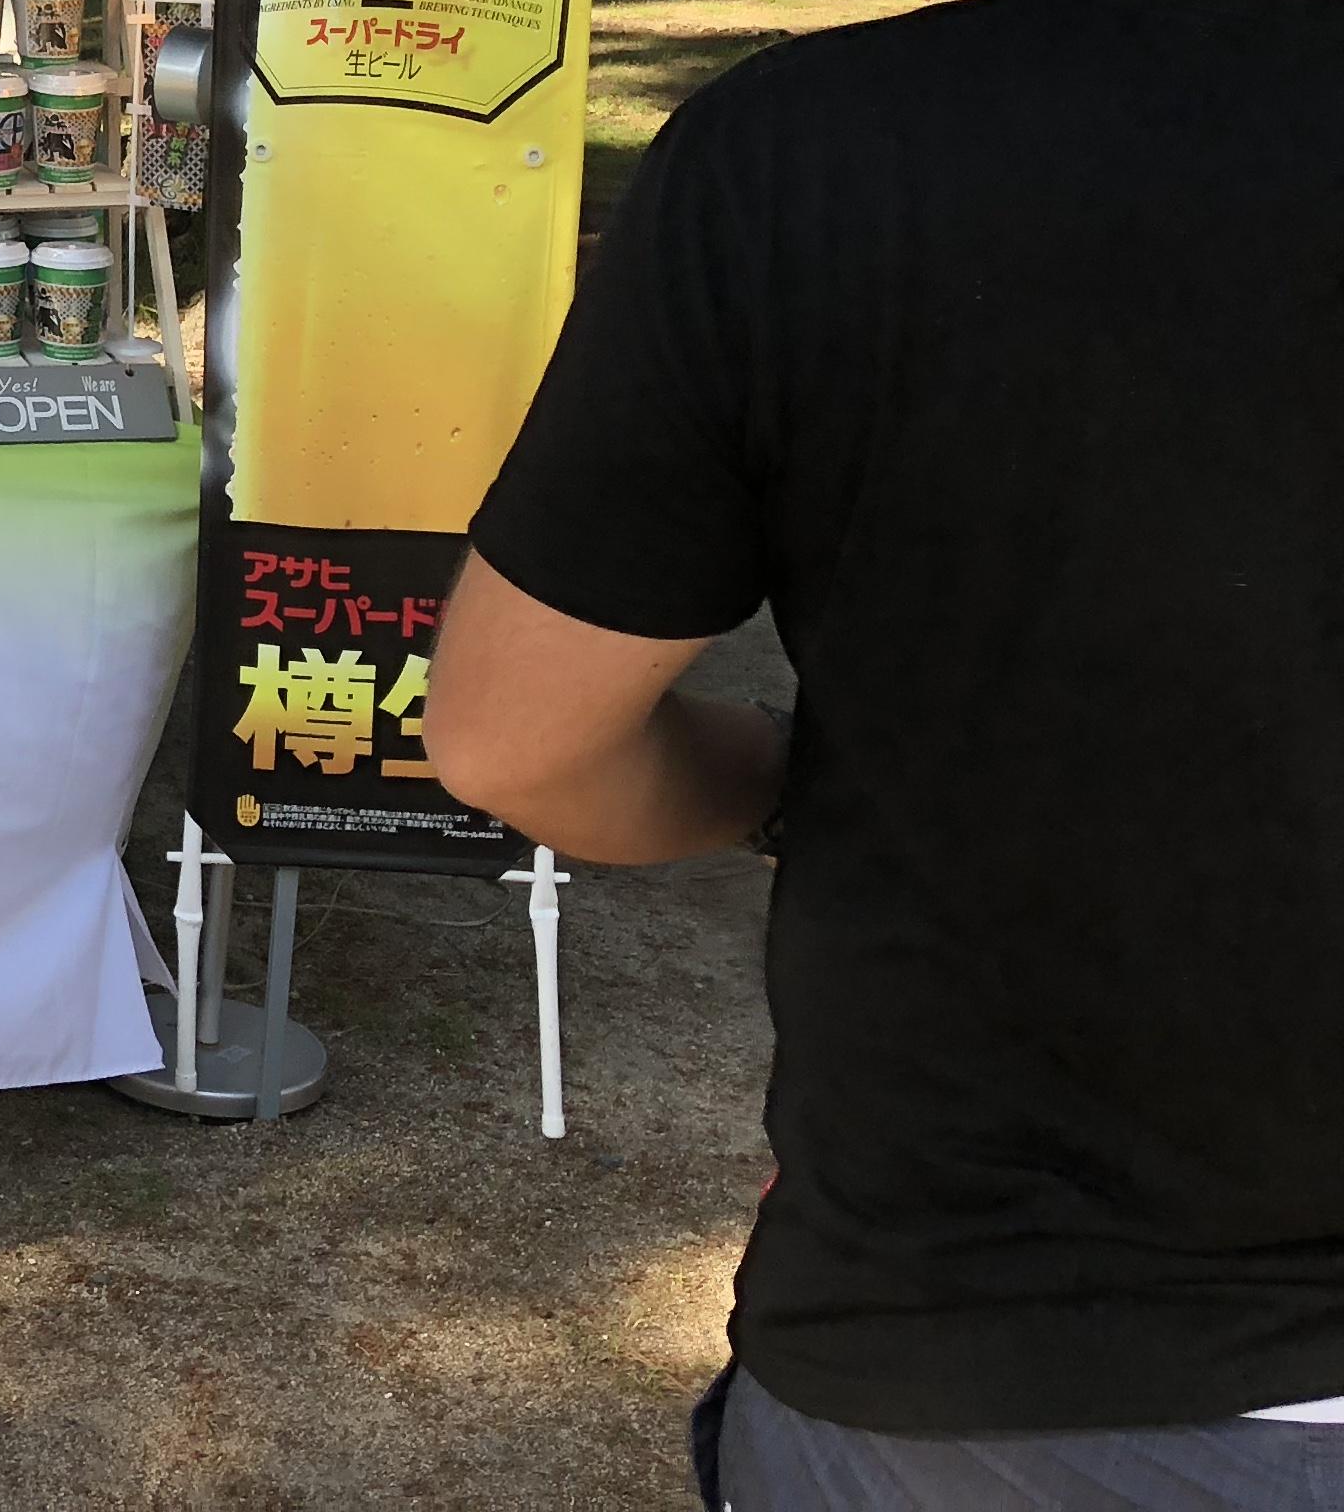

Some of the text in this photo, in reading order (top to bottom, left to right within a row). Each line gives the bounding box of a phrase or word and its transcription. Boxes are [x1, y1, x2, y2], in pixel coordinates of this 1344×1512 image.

[419, 1, 541, 31] BREWING TECHNIQUES
[306, 17, 466, 55] スーパードライ
[344, 49, 422, 80] 生ビール
[243, 551, 351, 591] アサヒ
[240, 589, 444, 638] スーパード
